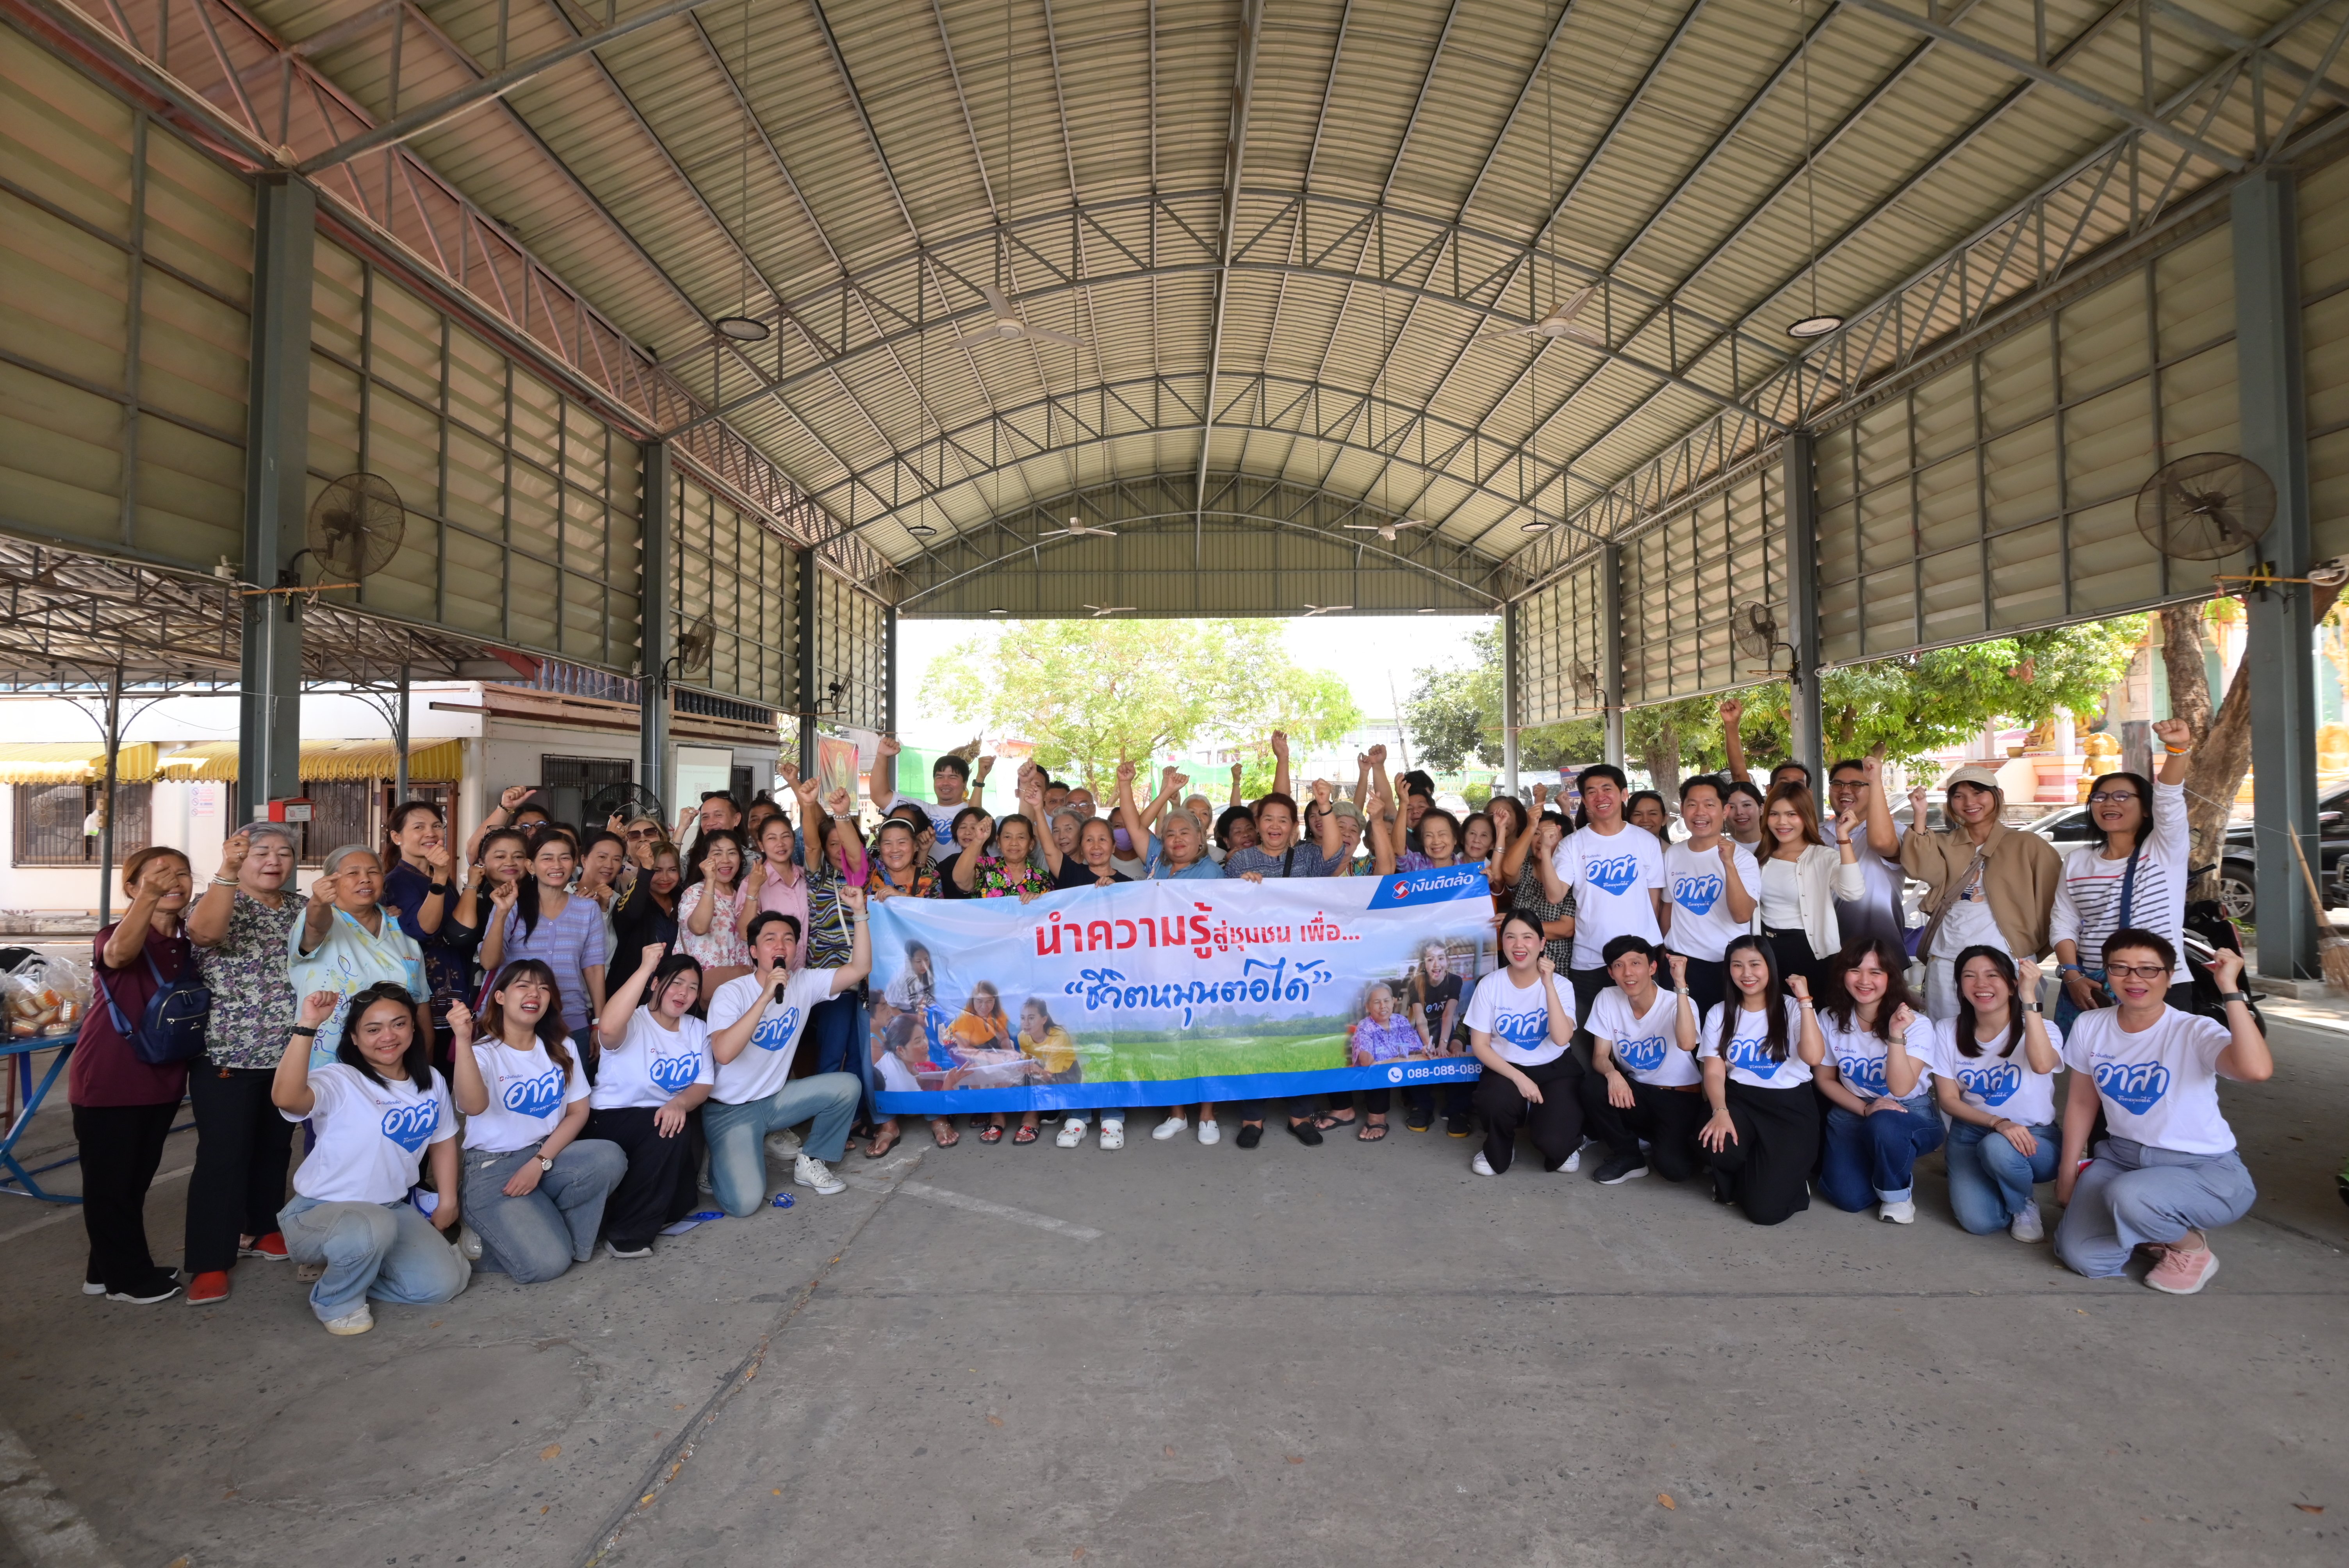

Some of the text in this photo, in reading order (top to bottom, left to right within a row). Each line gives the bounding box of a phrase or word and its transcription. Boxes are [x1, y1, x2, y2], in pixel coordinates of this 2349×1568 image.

[930, 818, 953, 832] าส
[1586, 855, 1637, 880] อาสา
[1411, 872, 1474, 893] เงินติดล้อ
[1674, 875, 1721, 900] อาสา
[1064, 957, 1332, 1029] “ชีวิตหมุนต่อได้”
[1426, 1001, 1446, 1013] อาส
[1618, 1037, 1665, 1061] อาสา
[1726, 1038, 1773, 1063] อาส
[652, 1054, 702, 1081] อาสา
[1407, 1064, 1484, 1079] 088-088-088
[1838, 1057, 1887, 1082] อาส
[1959, 1061, 2019, 1091] อาสา
[2094, 1063, 2167, 1094] อาสา
